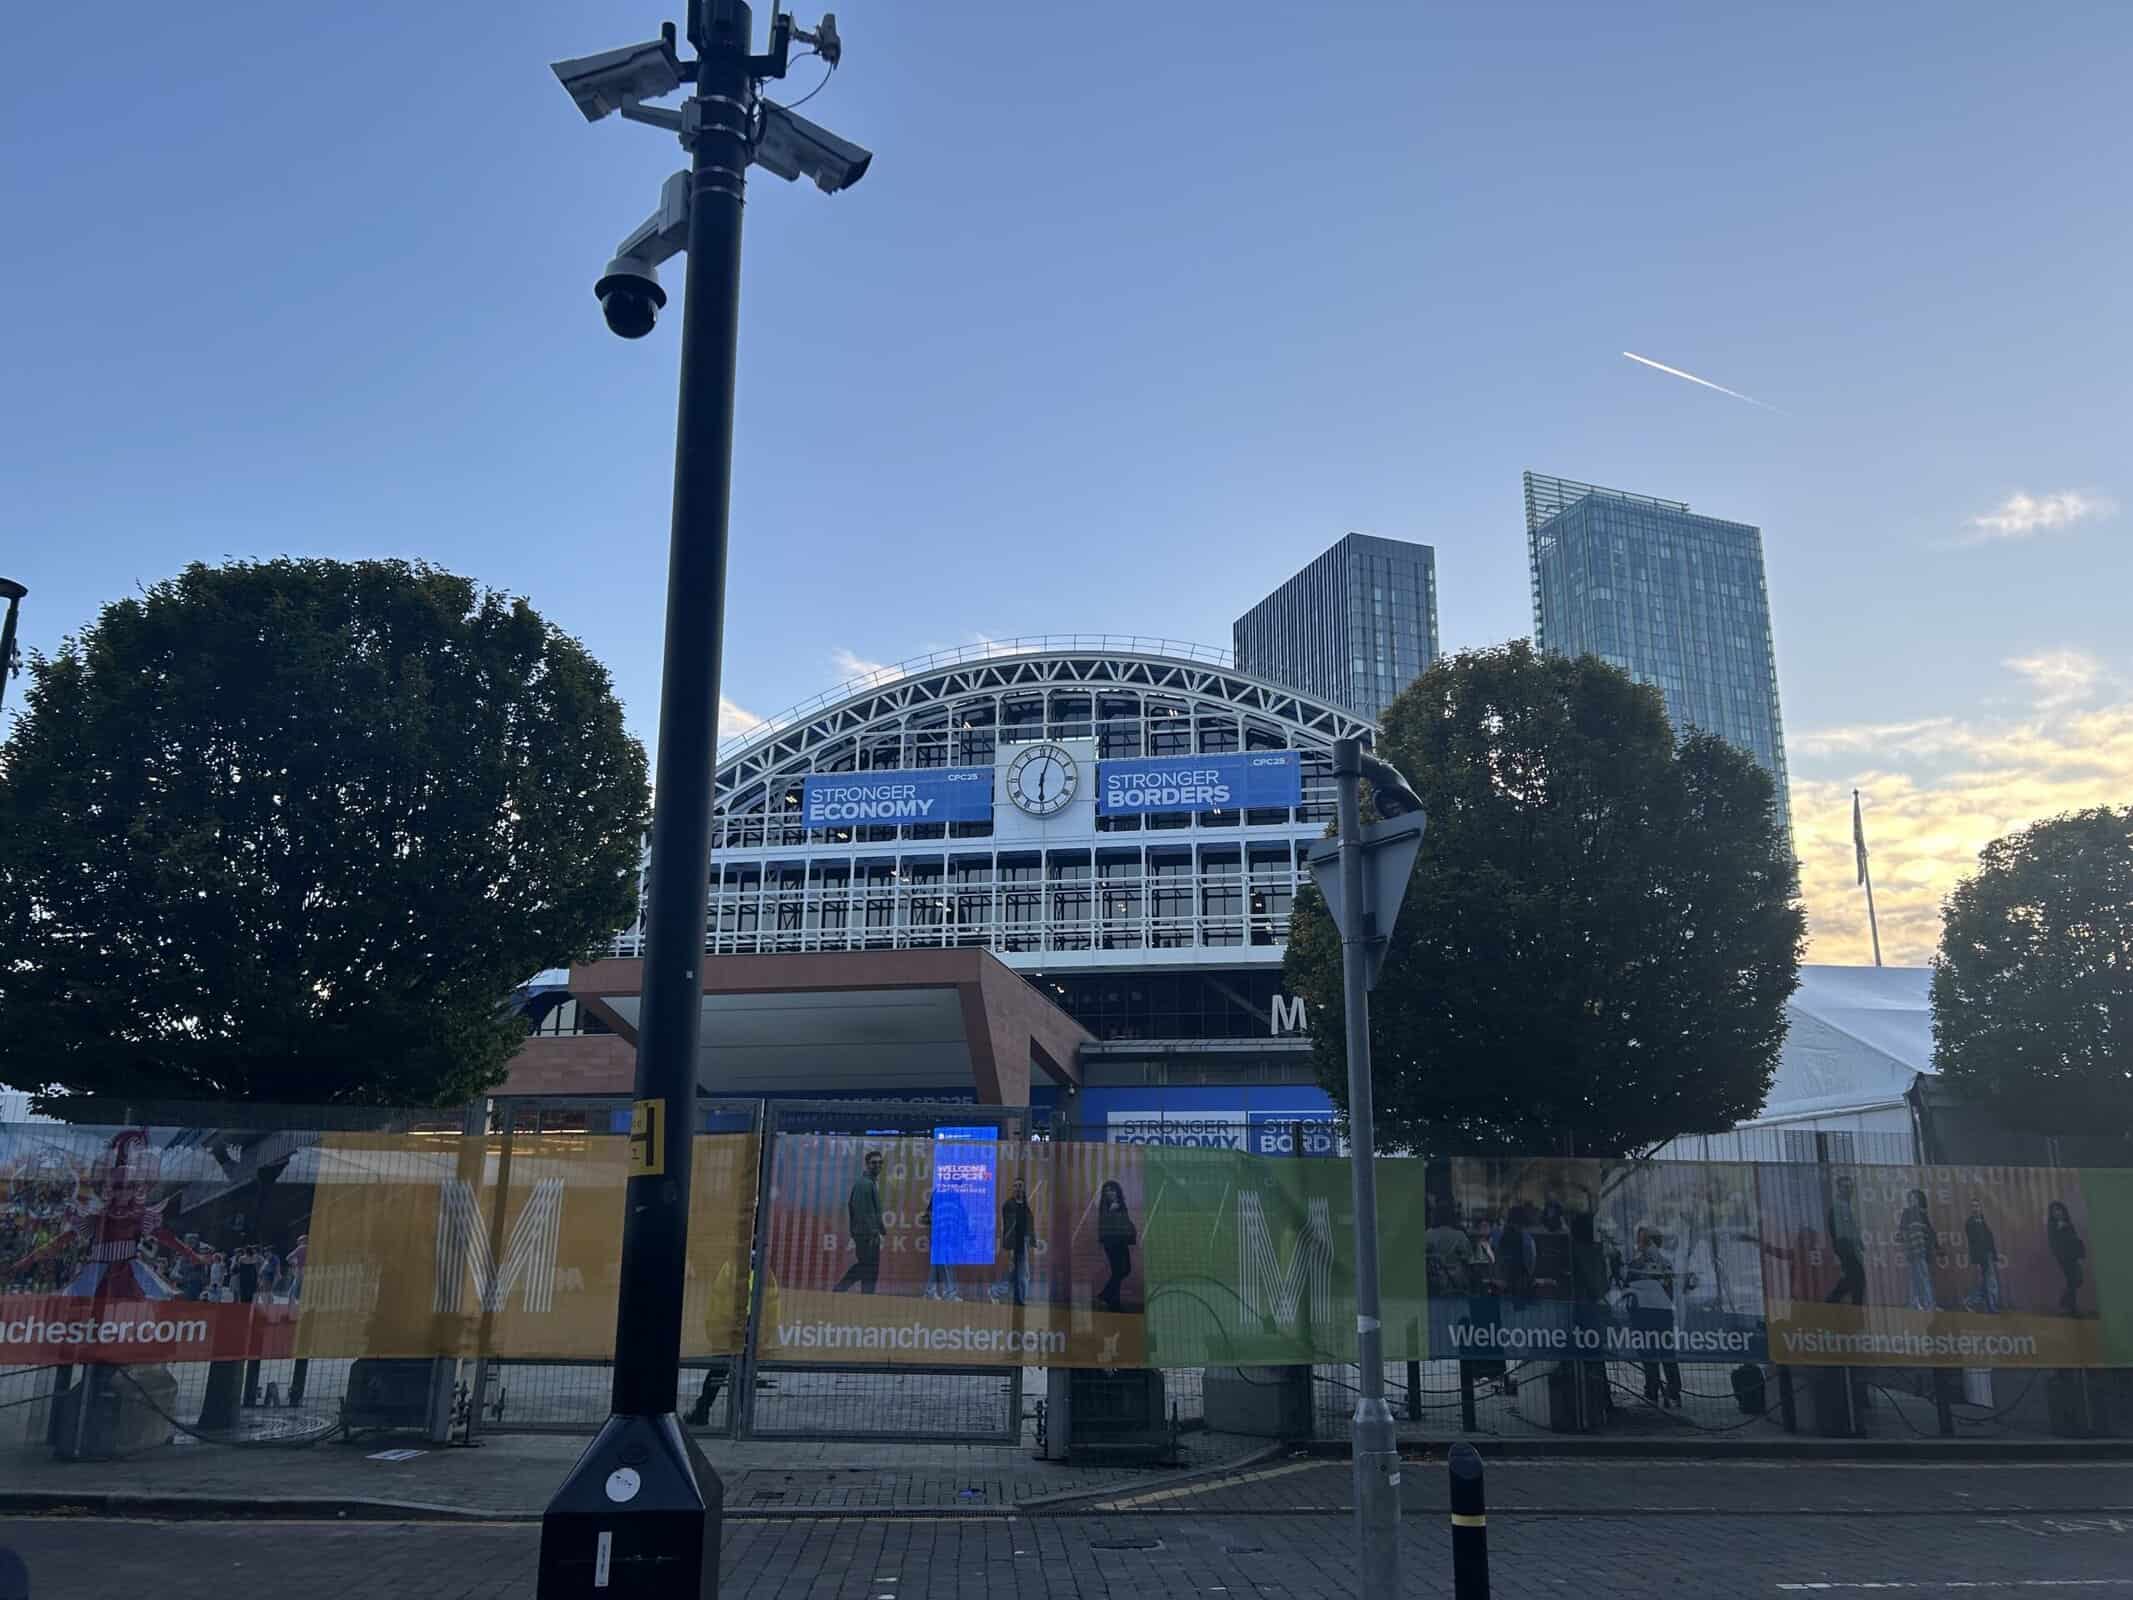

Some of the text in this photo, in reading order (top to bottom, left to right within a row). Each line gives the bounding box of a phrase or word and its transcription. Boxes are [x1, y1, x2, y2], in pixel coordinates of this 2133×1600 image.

[1252, 757, 1286, 767] CPC25
[1107, 769, 1220, 790] STRONGER
[810, 784, 916, 803] STRONGER
[1107, 785, 1231, 808] BORDERS
[809, 799, 935, 821] ECONOMY
[1122, 1119, 1230, 1134] STRONGER
[1263, 1118, 1340, 1134] STRON
[1260, 1135, 1338, 1153] BORD
[777, 1320, 1067, 1353] visitmanchester.com
[1448, 1322, 1753, 1351] Welcome to Manchester
[1781, 1327, 2038, 1356] visitmanchester.com
